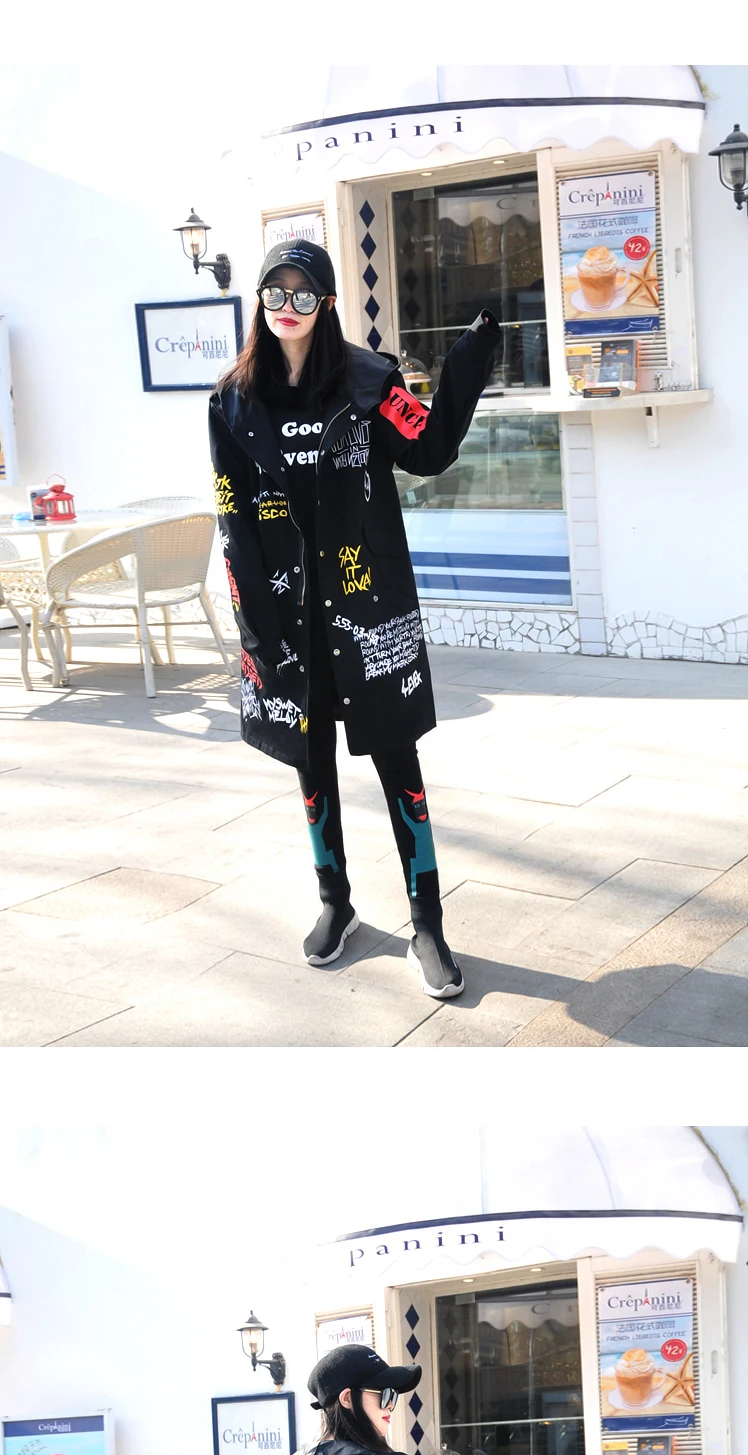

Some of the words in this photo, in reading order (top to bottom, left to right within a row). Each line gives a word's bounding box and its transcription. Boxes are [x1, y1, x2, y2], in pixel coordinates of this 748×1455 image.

[296, 116, 465, 161] panini
[568, 232, 593, 240] FRENCH
[625, 227, 650, 235] COFFEE
[338, 545, 361, 569] SAY
[345, 564, 361, 580] IT
[350, 1226, 506, 1267] panini
